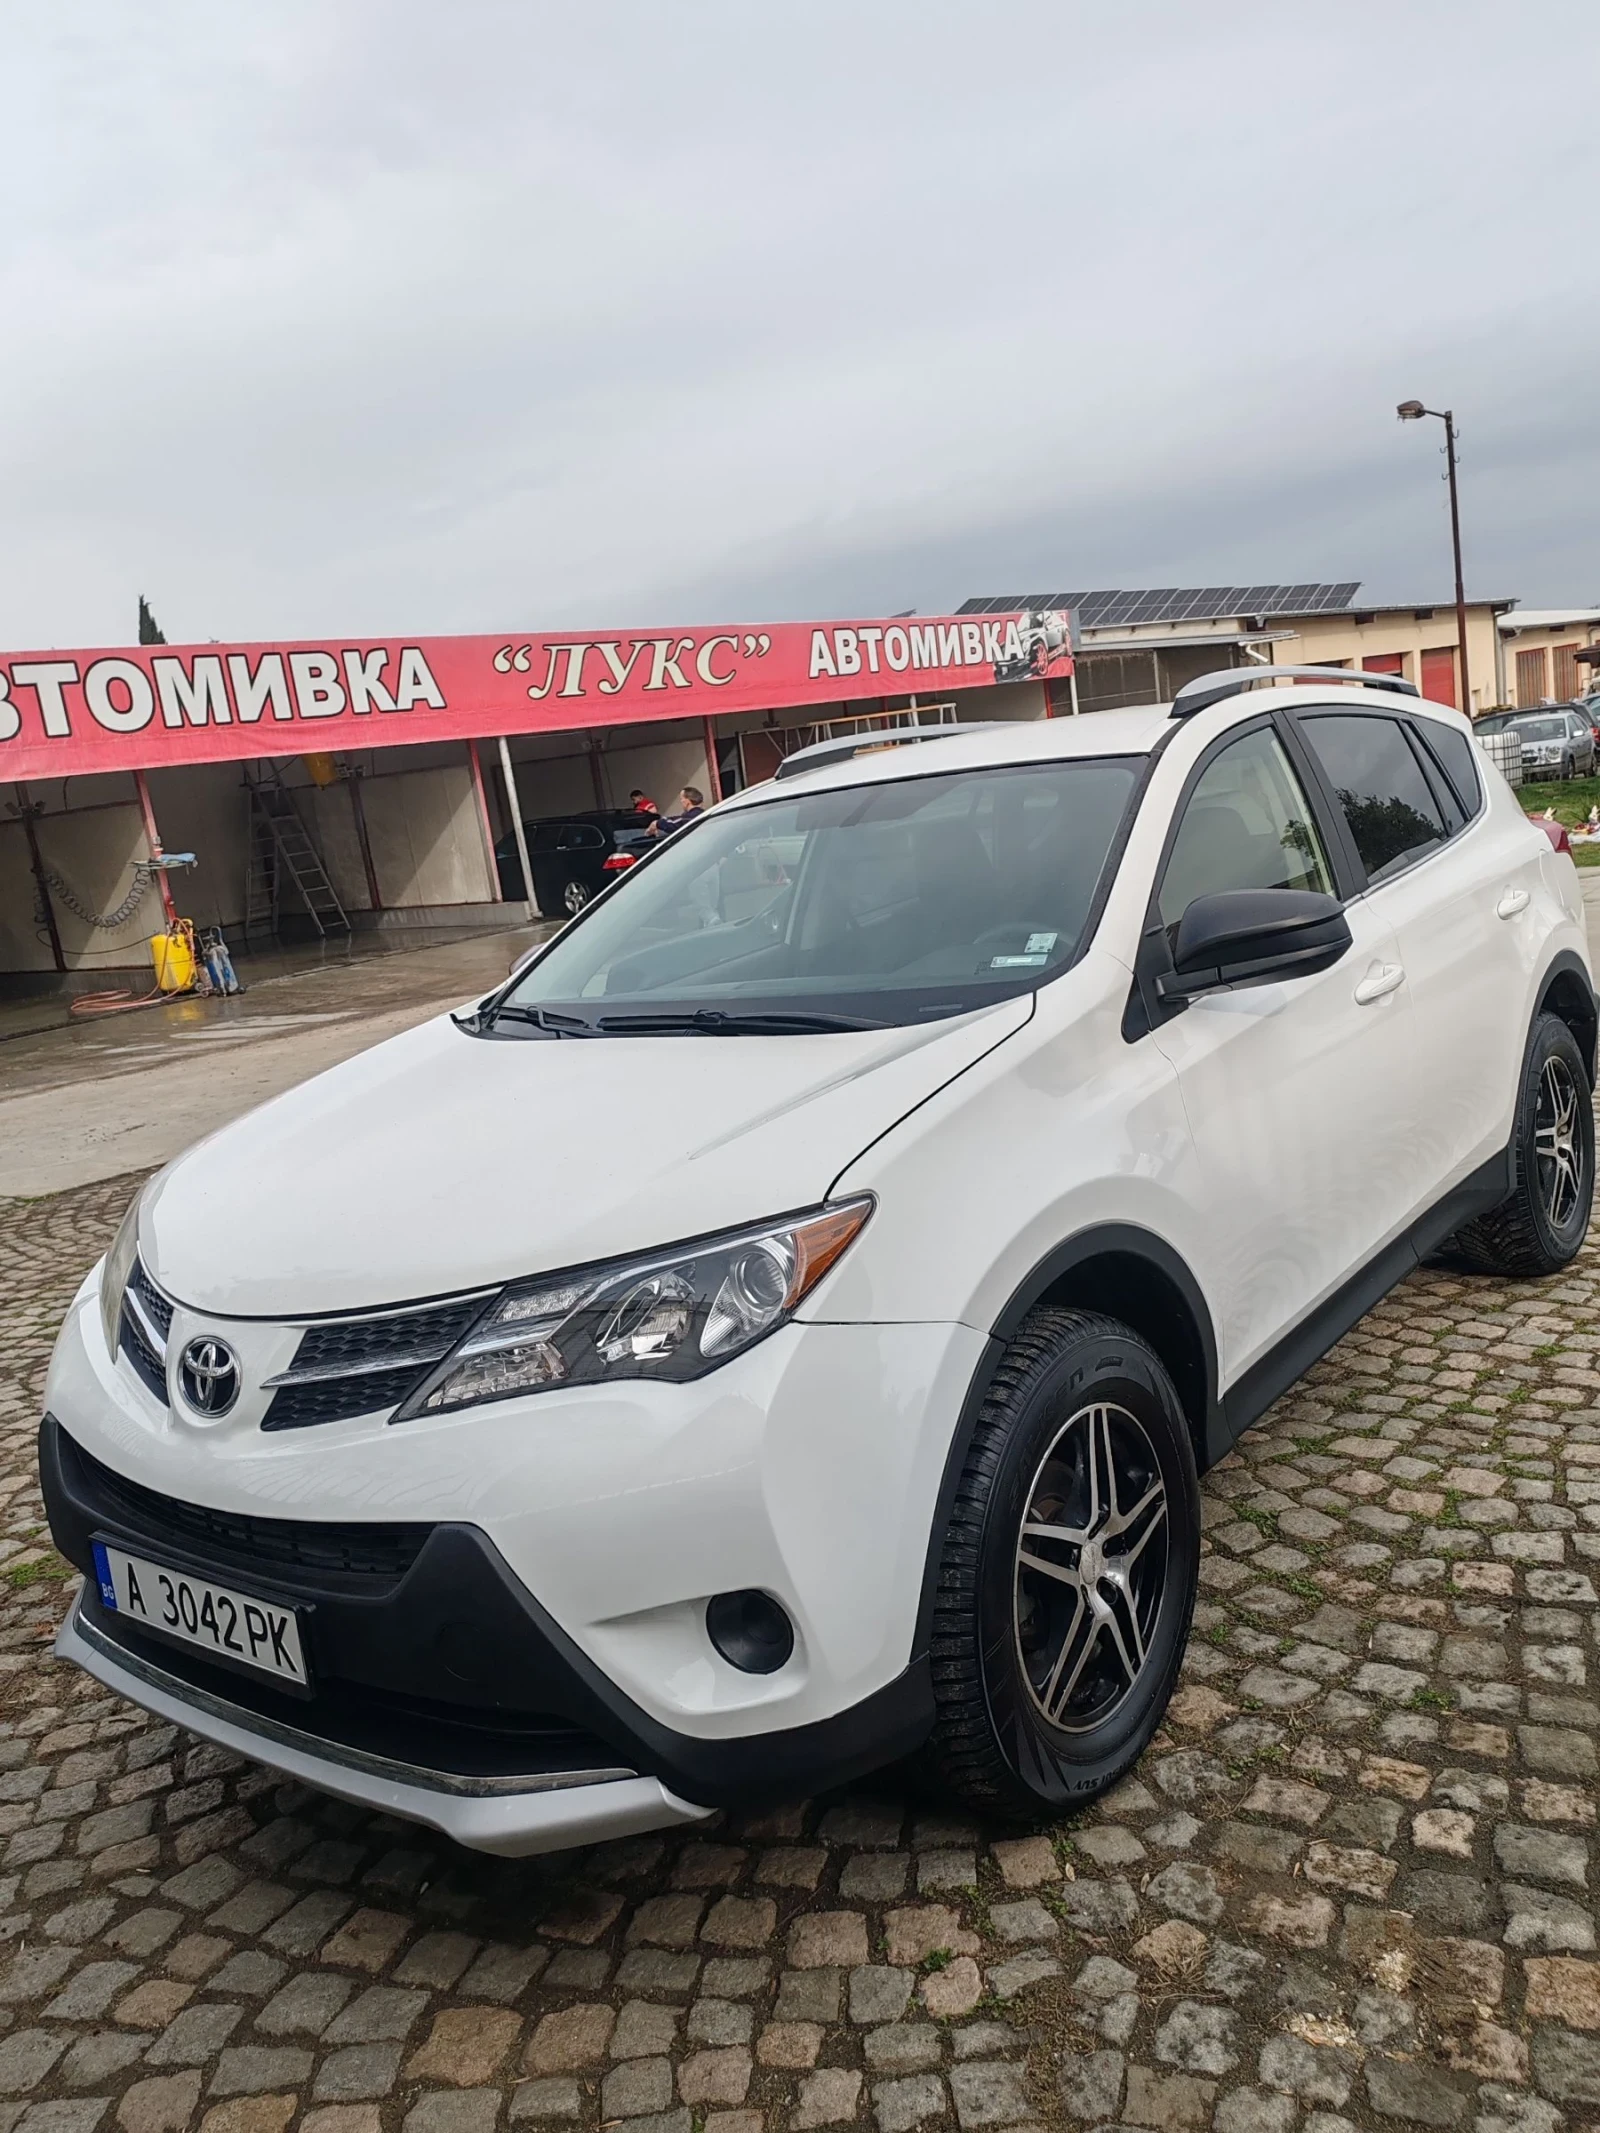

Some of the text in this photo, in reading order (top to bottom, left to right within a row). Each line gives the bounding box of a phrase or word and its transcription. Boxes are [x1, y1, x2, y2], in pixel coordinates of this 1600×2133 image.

[493, 634, 771, 699] “ЛУКС”
[808, 620, 1025, 679] АВТОМИВКА
[102, 1583, 115, 1600] BG
